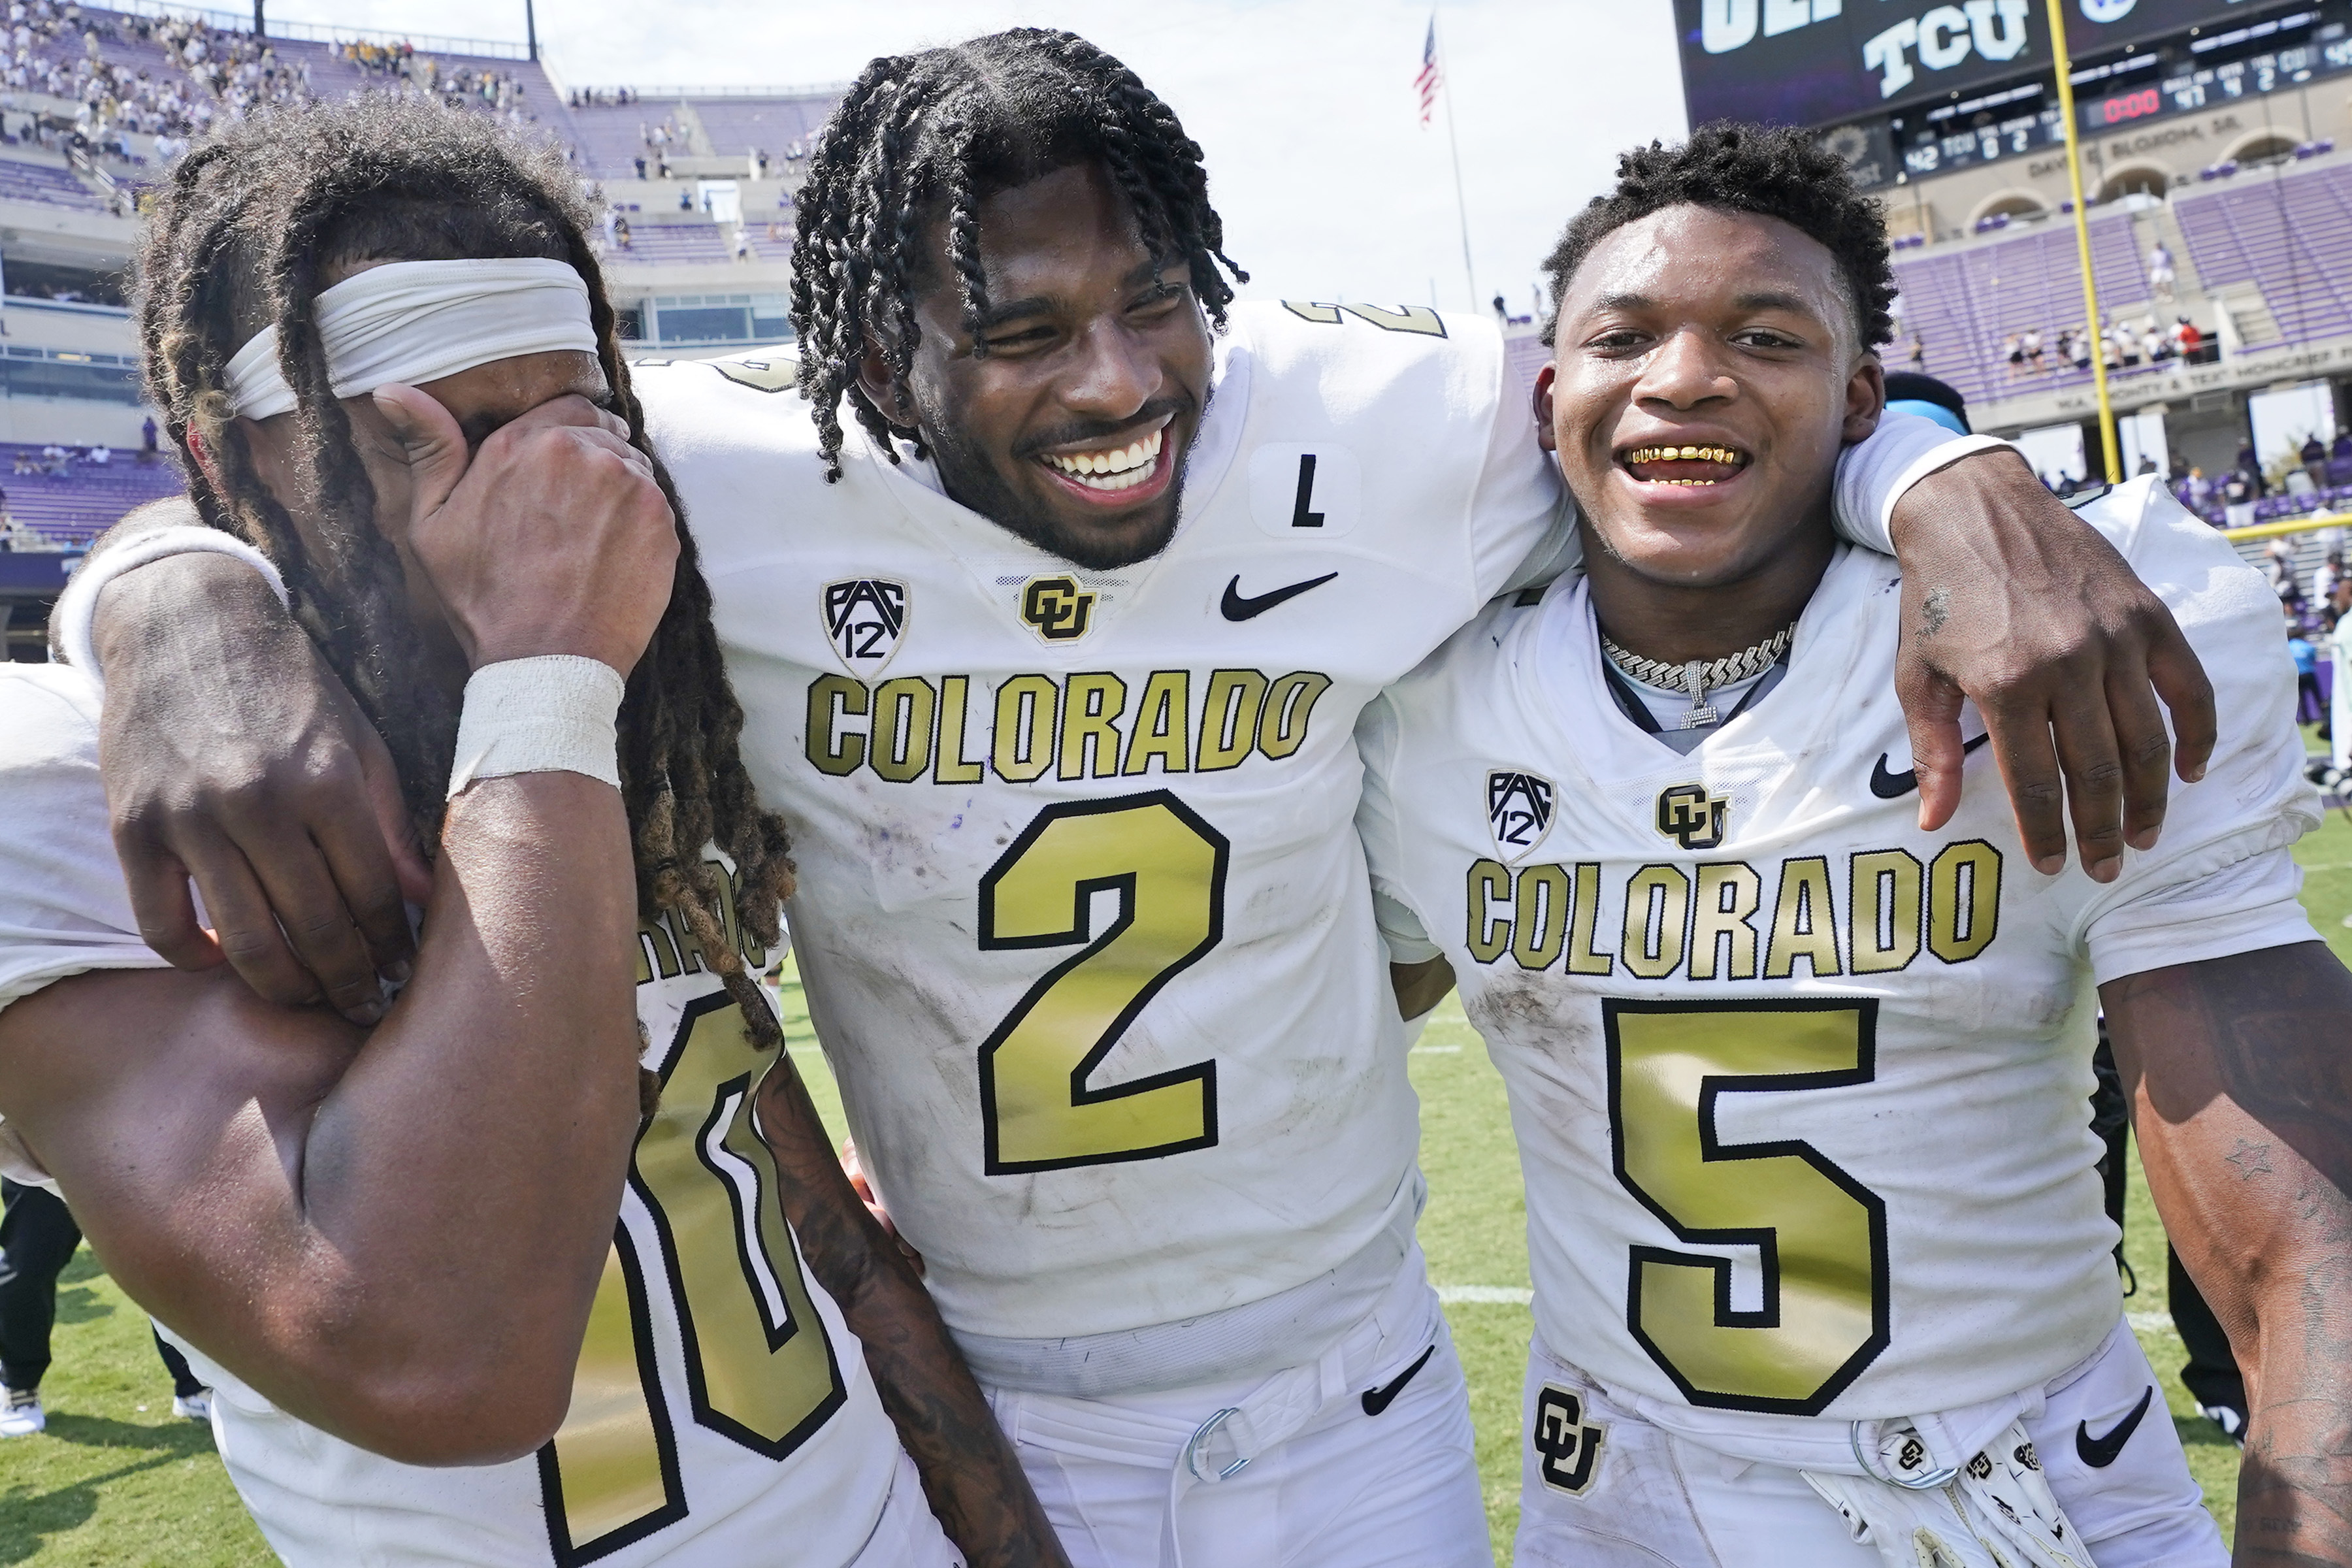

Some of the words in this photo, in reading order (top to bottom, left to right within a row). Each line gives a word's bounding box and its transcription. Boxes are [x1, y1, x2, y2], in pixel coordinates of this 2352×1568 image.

[1863, 0, 2029, 99] TCU
[2258, 67, 2274, 91] 2
[2103, 89, 2159, 123] 0:00
[2012, 129, 2028, 152] 2
[1292, 453, 1325, 528] L
[826, 580, 904, 640] PAC
[845, 621, 885, 659] 12
[1024, 579, 1094, 639] CU
[805, 668, 1334, 785] COLORADO
[1489, 773, 1551, 832] PAC
[1498, 810, 1535, 846] 12
[1659, 783, 1726, 849] CU
[1465, 837, 2004, 982] COLORADO
[977, 788, 1230, 1177] 2
[1601, 996, 1891, 1418] 5
[1534, 1386, 1602, 1492] CU
